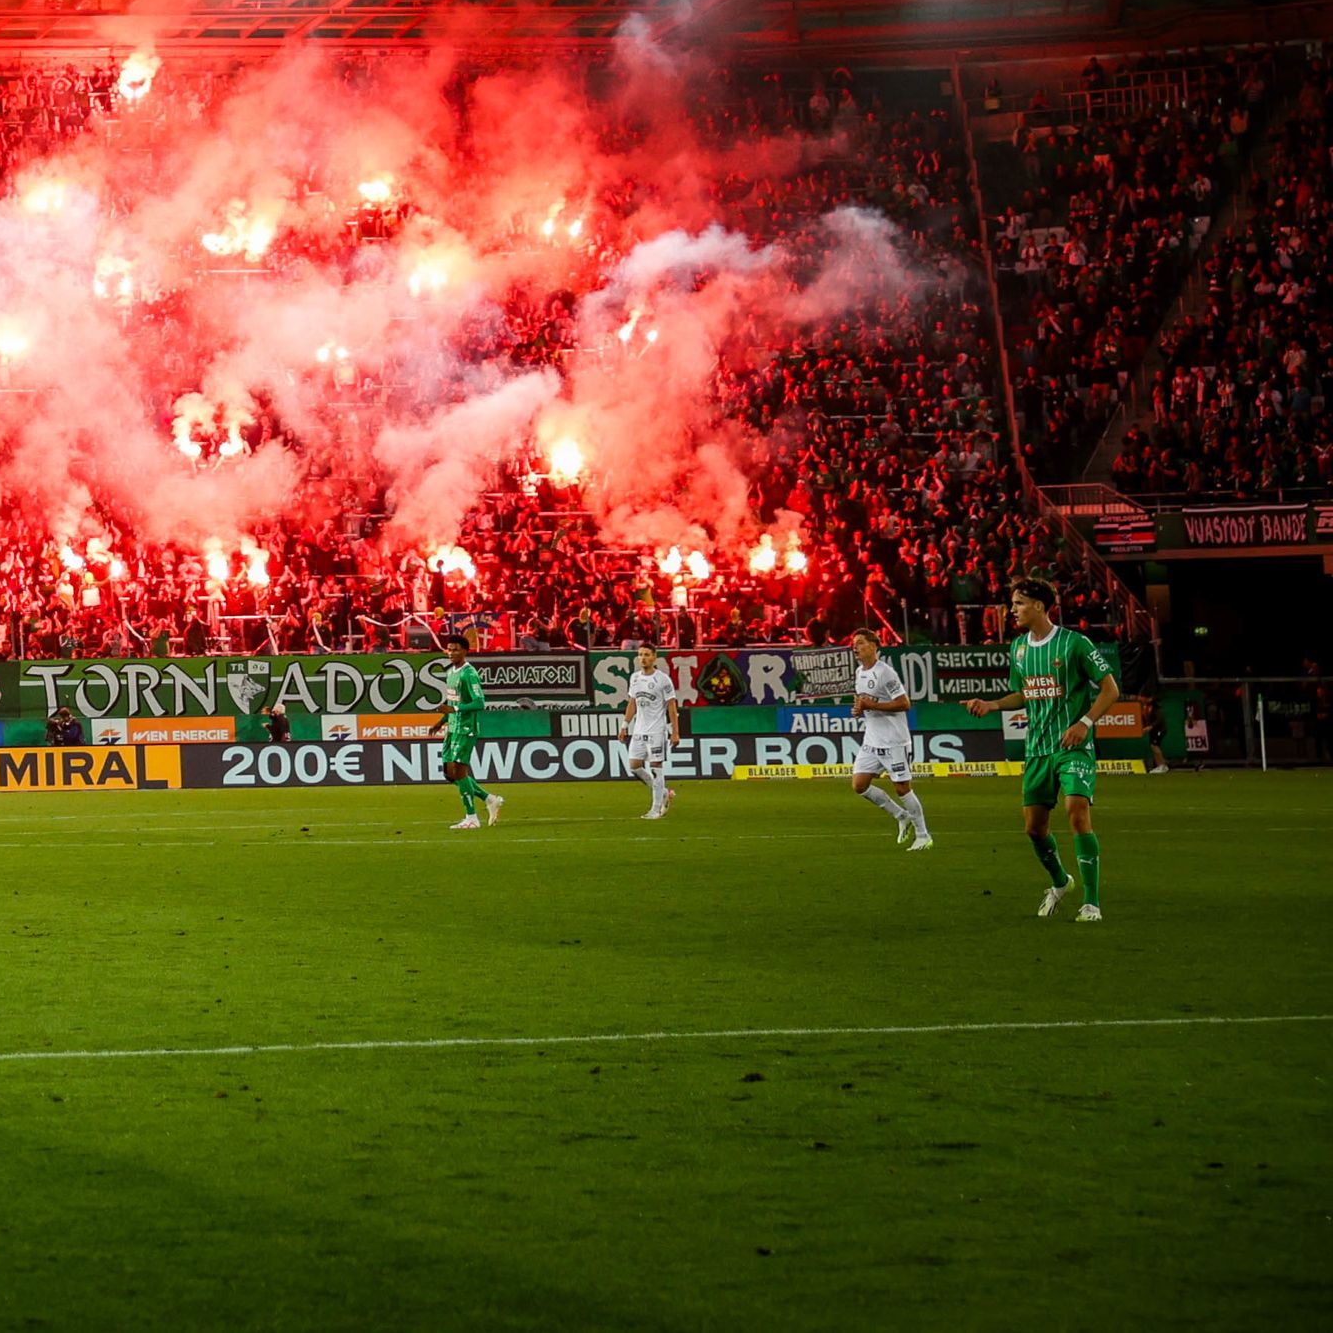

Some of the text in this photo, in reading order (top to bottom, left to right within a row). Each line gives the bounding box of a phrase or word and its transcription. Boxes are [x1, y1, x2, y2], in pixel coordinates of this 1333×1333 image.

[1261, 512, 1308, 544] BANDE
[1088, 649, 1110, 672] N26
[230, 663, 244, 672] TR
[939, 678, 1012, 694] MEIDLIN
[1025, 676, 1055, 687] WIEN
[1023, 686, 1062, 699] ENERGIE
[1096, 714, 1136, 726] ERGIE
[132, 729, 229, 742] WIEN ENERGIE
[362, 726, 397, 738] WIEN
[222, 743, 366, 786] 200€
